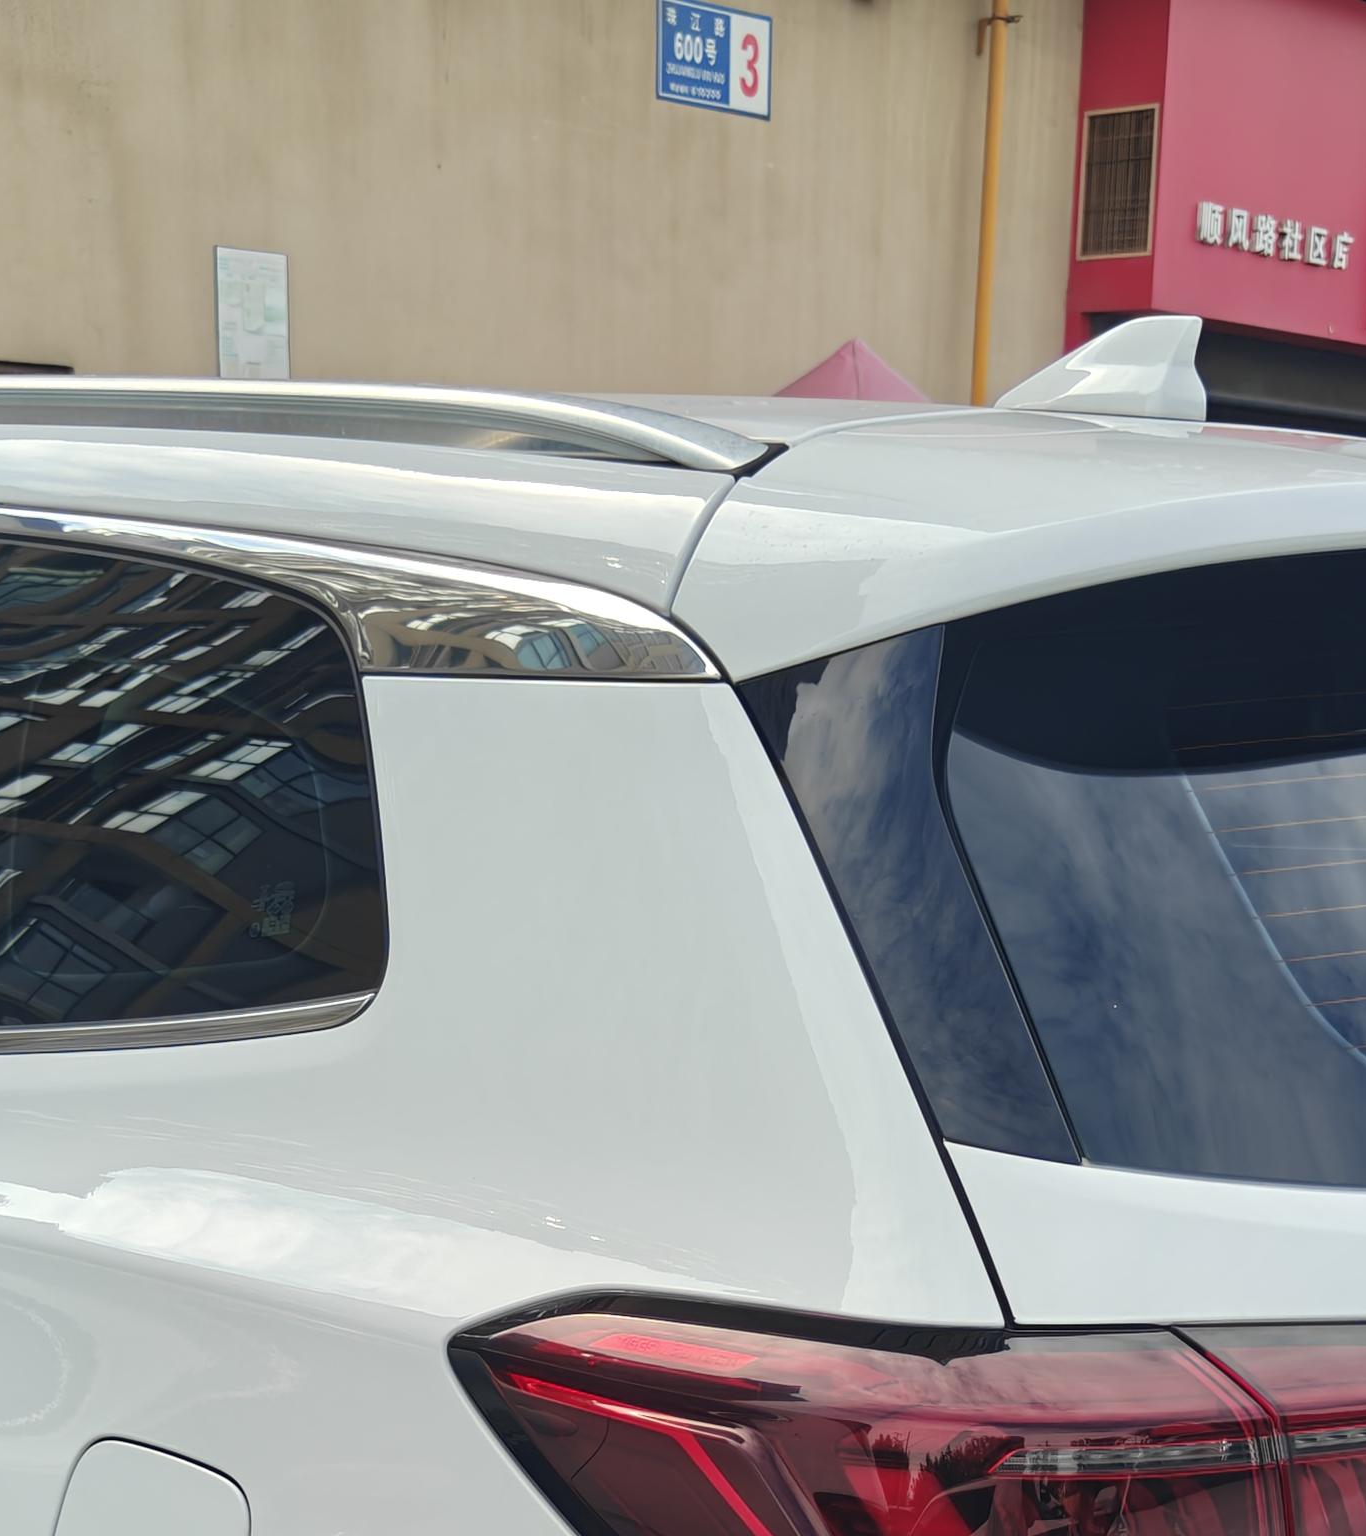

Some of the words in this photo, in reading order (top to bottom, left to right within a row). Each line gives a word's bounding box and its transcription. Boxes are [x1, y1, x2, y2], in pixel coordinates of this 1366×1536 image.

[673, 32, 717, 66] 600号
[739, 33, 759, 97] 3
[1196, 200, 1355, 271] 顺风路社区店
